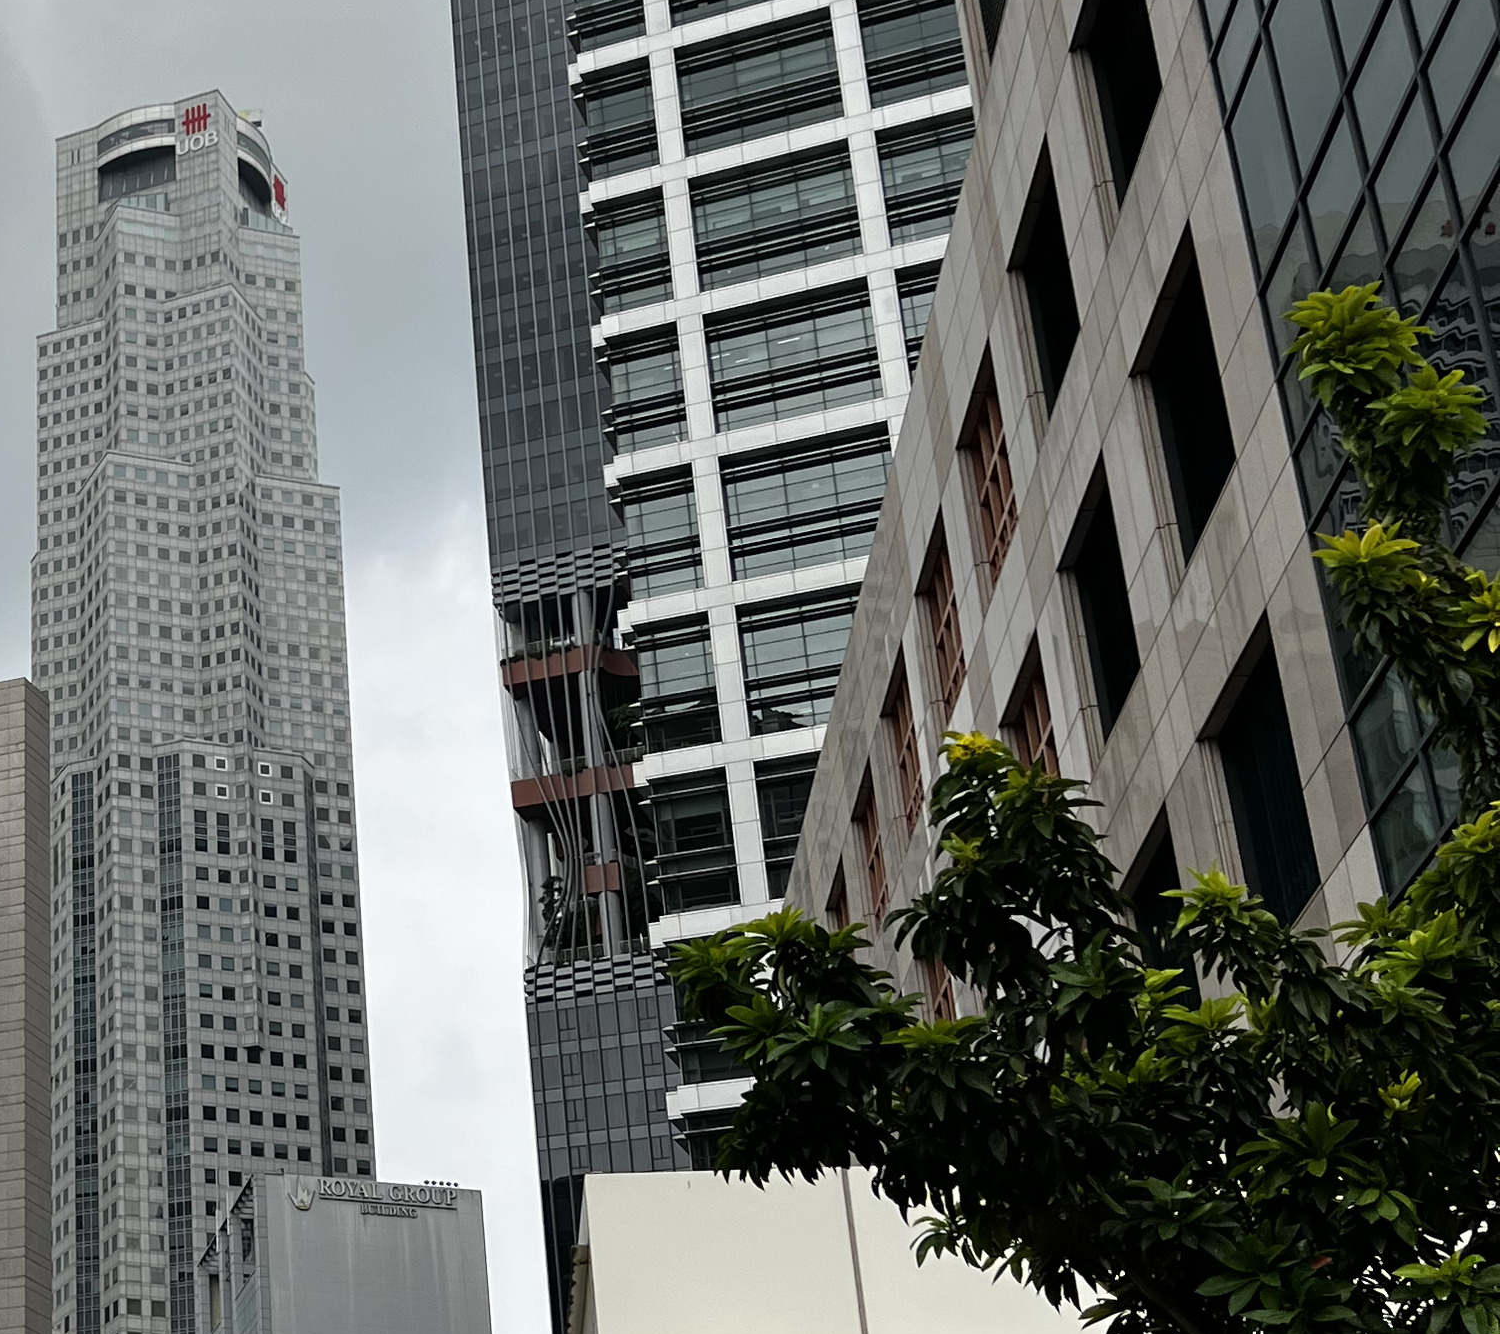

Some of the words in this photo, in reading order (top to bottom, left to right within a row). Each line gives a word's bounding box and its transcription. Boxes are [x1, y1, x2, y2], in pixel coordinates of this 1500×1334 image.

[176, 130, 219, 156] UOB
[318, 1179, 383, 1200] ROYAL
[389, 1184, 457, 1206] GROUP
[360, 1202, 418, 1218] BUILDING
